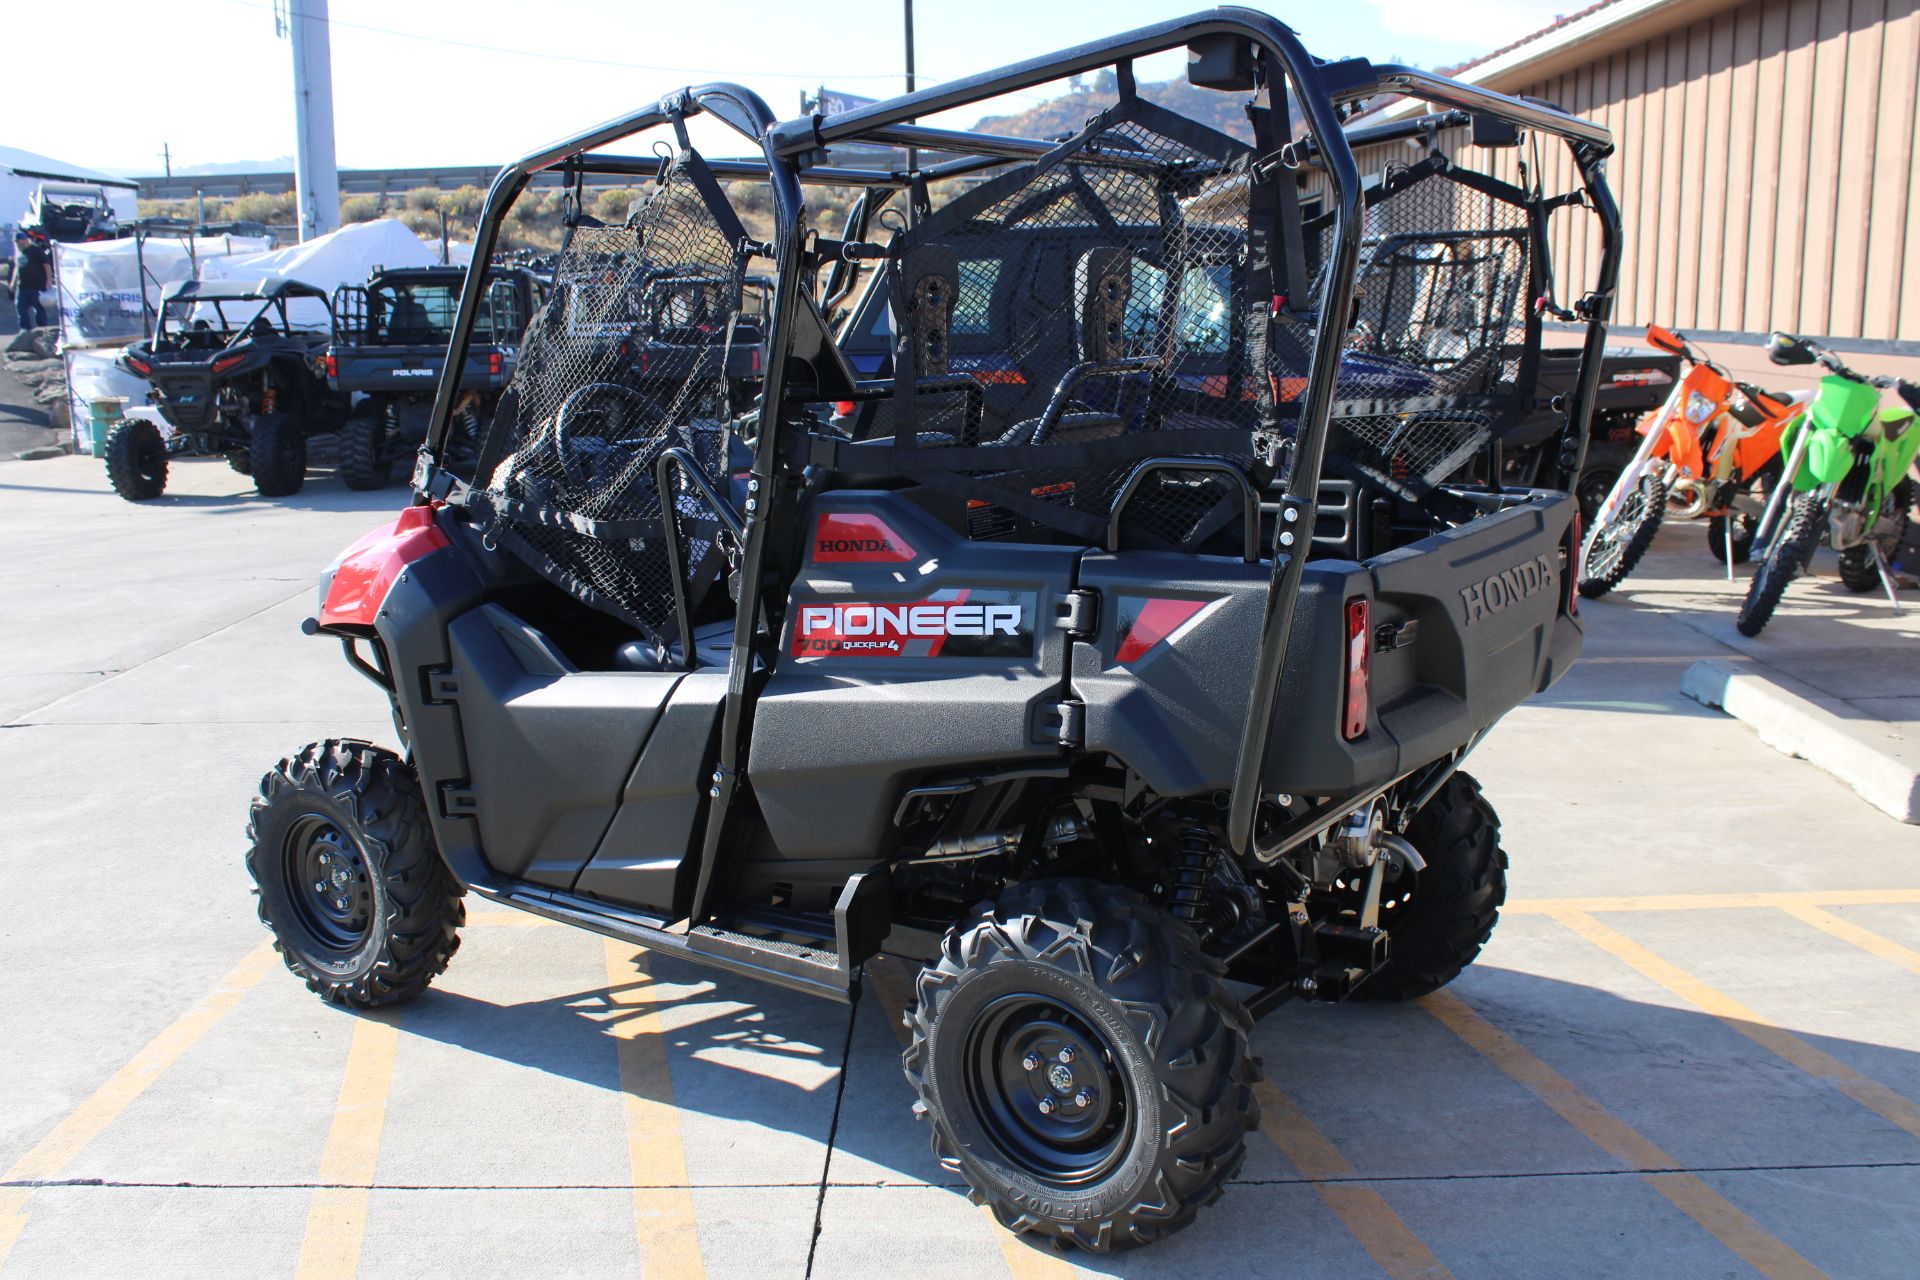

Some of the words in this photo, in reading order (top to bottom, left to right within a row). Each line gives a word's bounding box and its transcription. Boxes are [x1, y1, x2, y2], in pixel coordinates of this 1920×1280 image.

[79, 291, 143, 303] POLARIS
[819, 539, 897, 553] HONDA
[1459, 554, 1553, 626] HONDA
[803, 606, 1021, 635] PIONEER
[797, 638, 842, 651] 700
